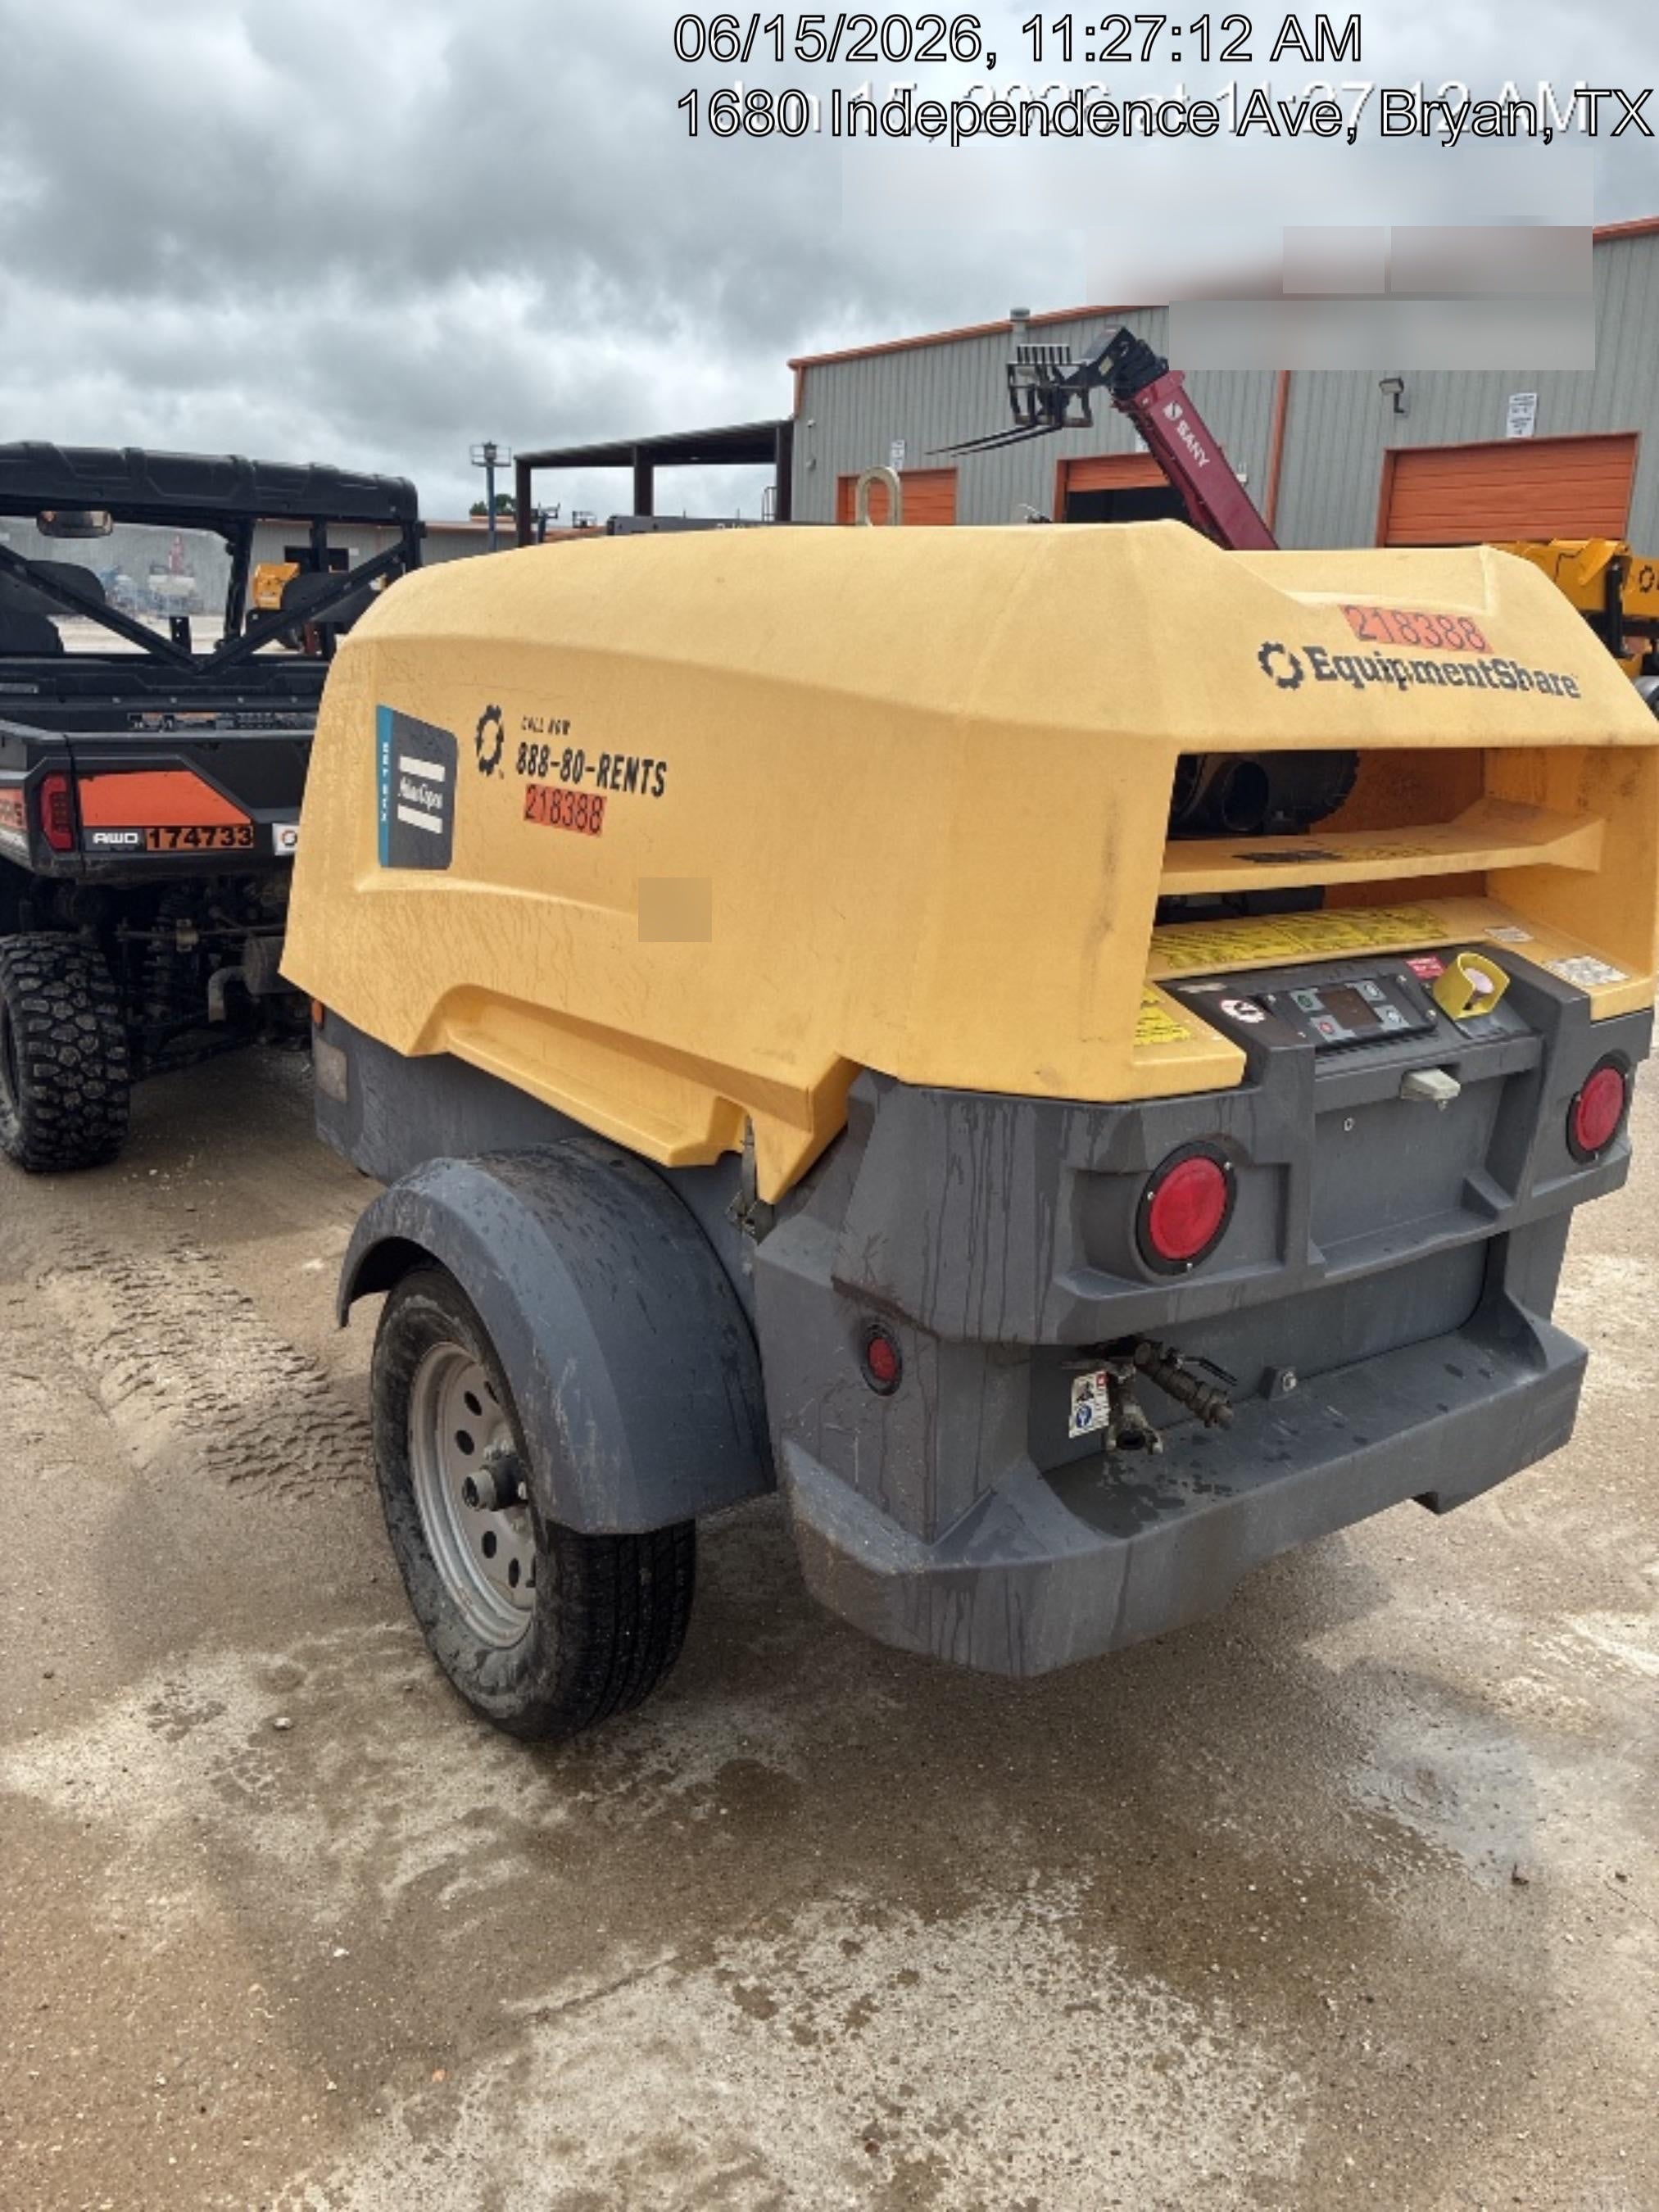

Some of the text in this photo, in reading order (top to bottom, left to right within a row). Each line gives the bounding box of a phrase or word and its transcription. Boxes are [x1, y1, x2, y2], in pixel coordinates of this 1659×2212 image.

[1176, 419, 1210, 468] SANY
[1344, 604, 1486, 651] 218388
[1302, 645, 1582, 700] EquipmentShare
[515, 741, 668, 799] 888-80-RENTS
[524, 784, 605, 836] 218388
[93, 832, 138, 845] AWD
[149, 826, 253, 849] 174733
